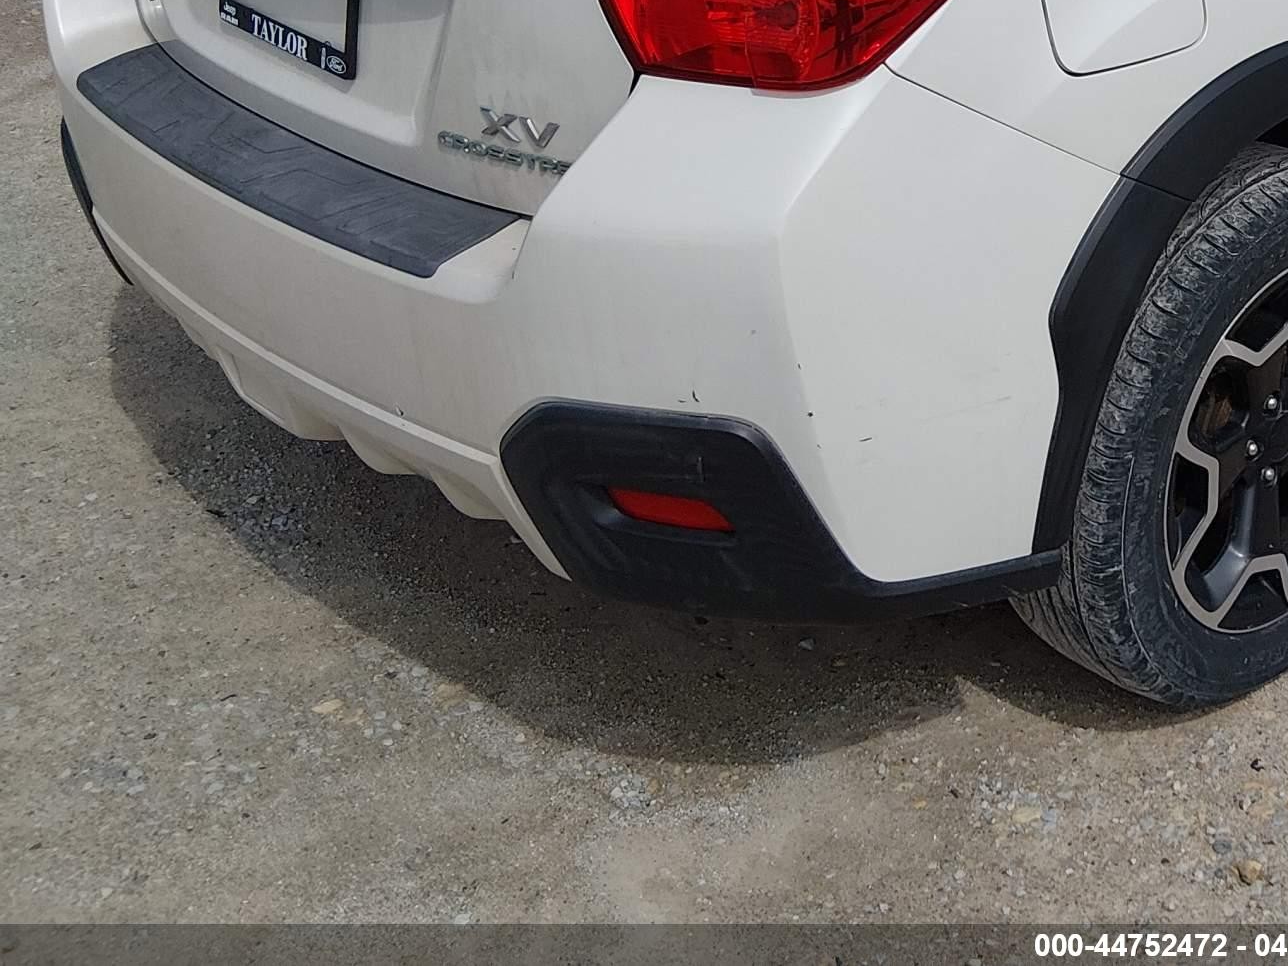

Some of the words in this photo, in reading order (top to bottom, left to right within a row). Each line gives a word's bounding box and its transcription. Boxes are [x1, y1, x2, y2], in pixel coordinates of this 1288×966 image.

[251, 13, 308, 61] TAYLOR
[479, 106, 560, 149] XV
[437, 130, 574, 175] CROSSTRE
